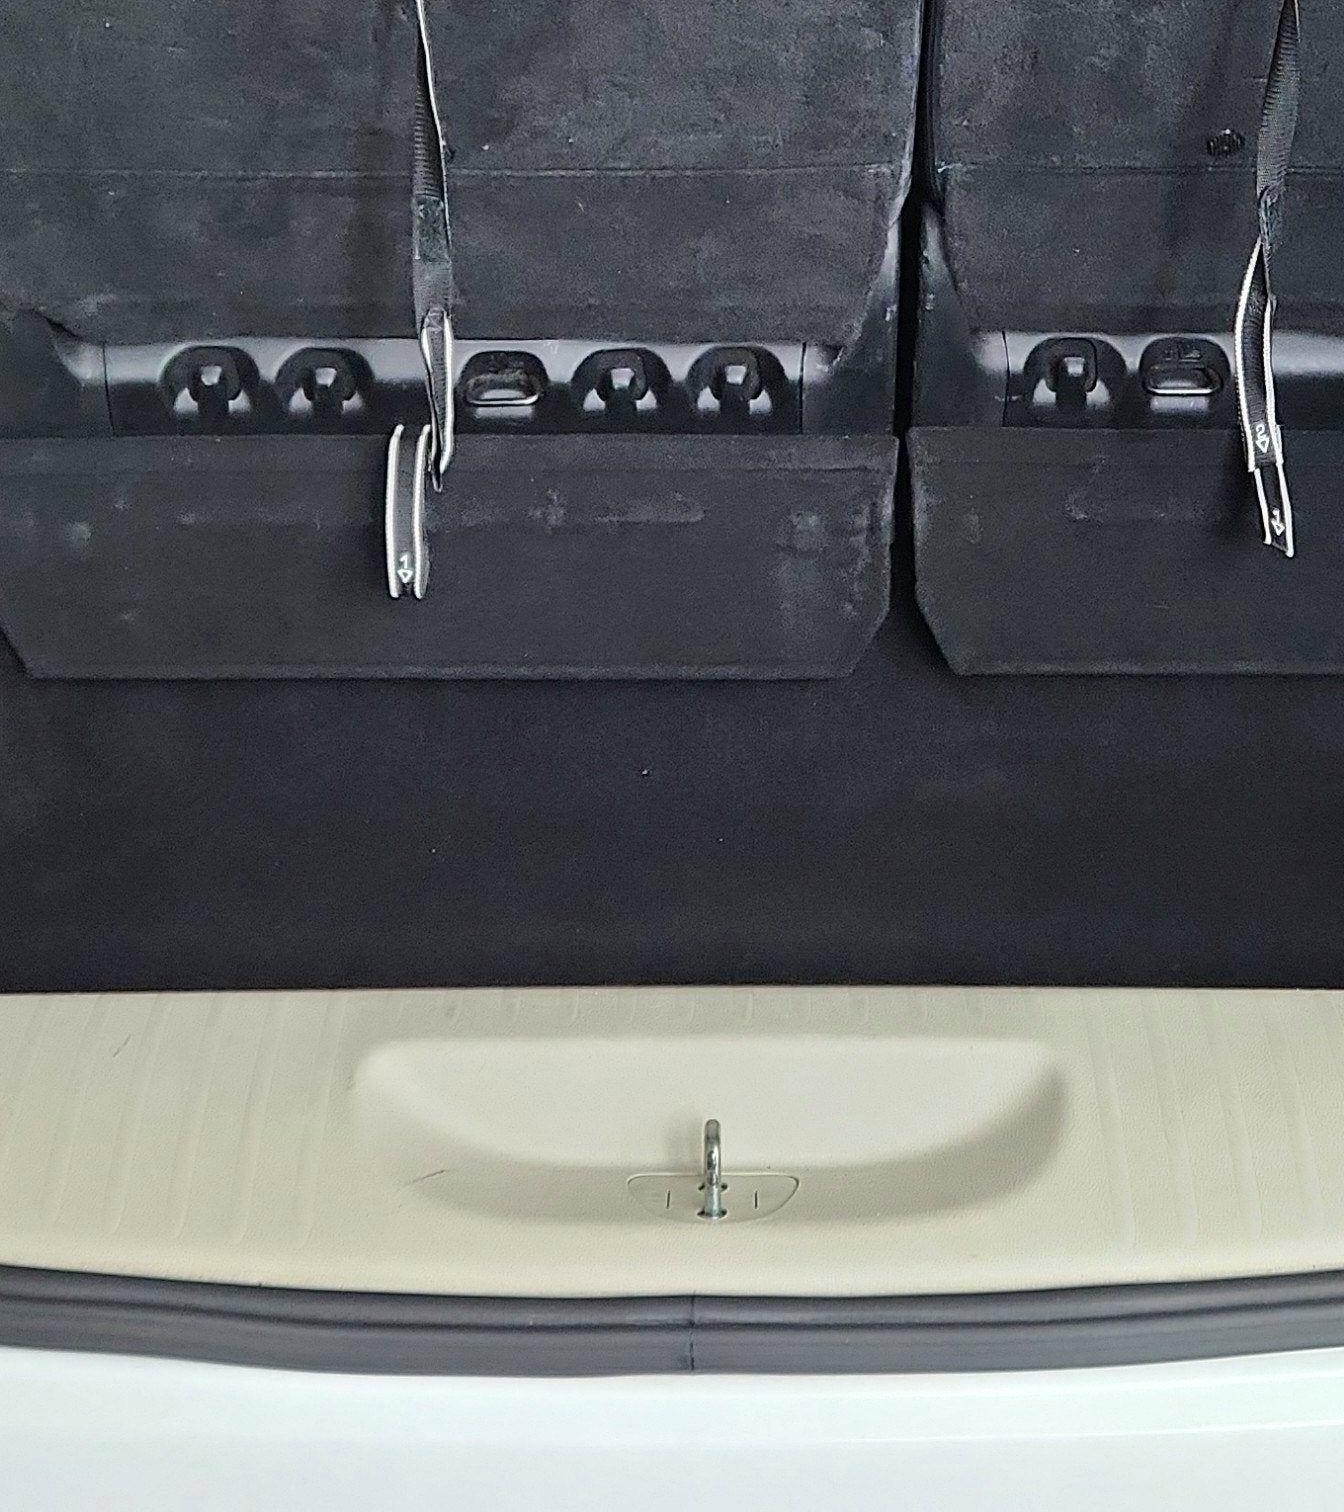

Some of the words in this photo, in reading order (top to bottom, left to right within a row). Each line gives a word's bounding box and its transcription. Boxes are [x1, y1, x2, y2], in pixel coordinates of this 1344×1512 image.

[1255, 423, 1267, 439] 2
[1271, 507, 1281, 523] 1
[399, 553, 408, 569] 1
